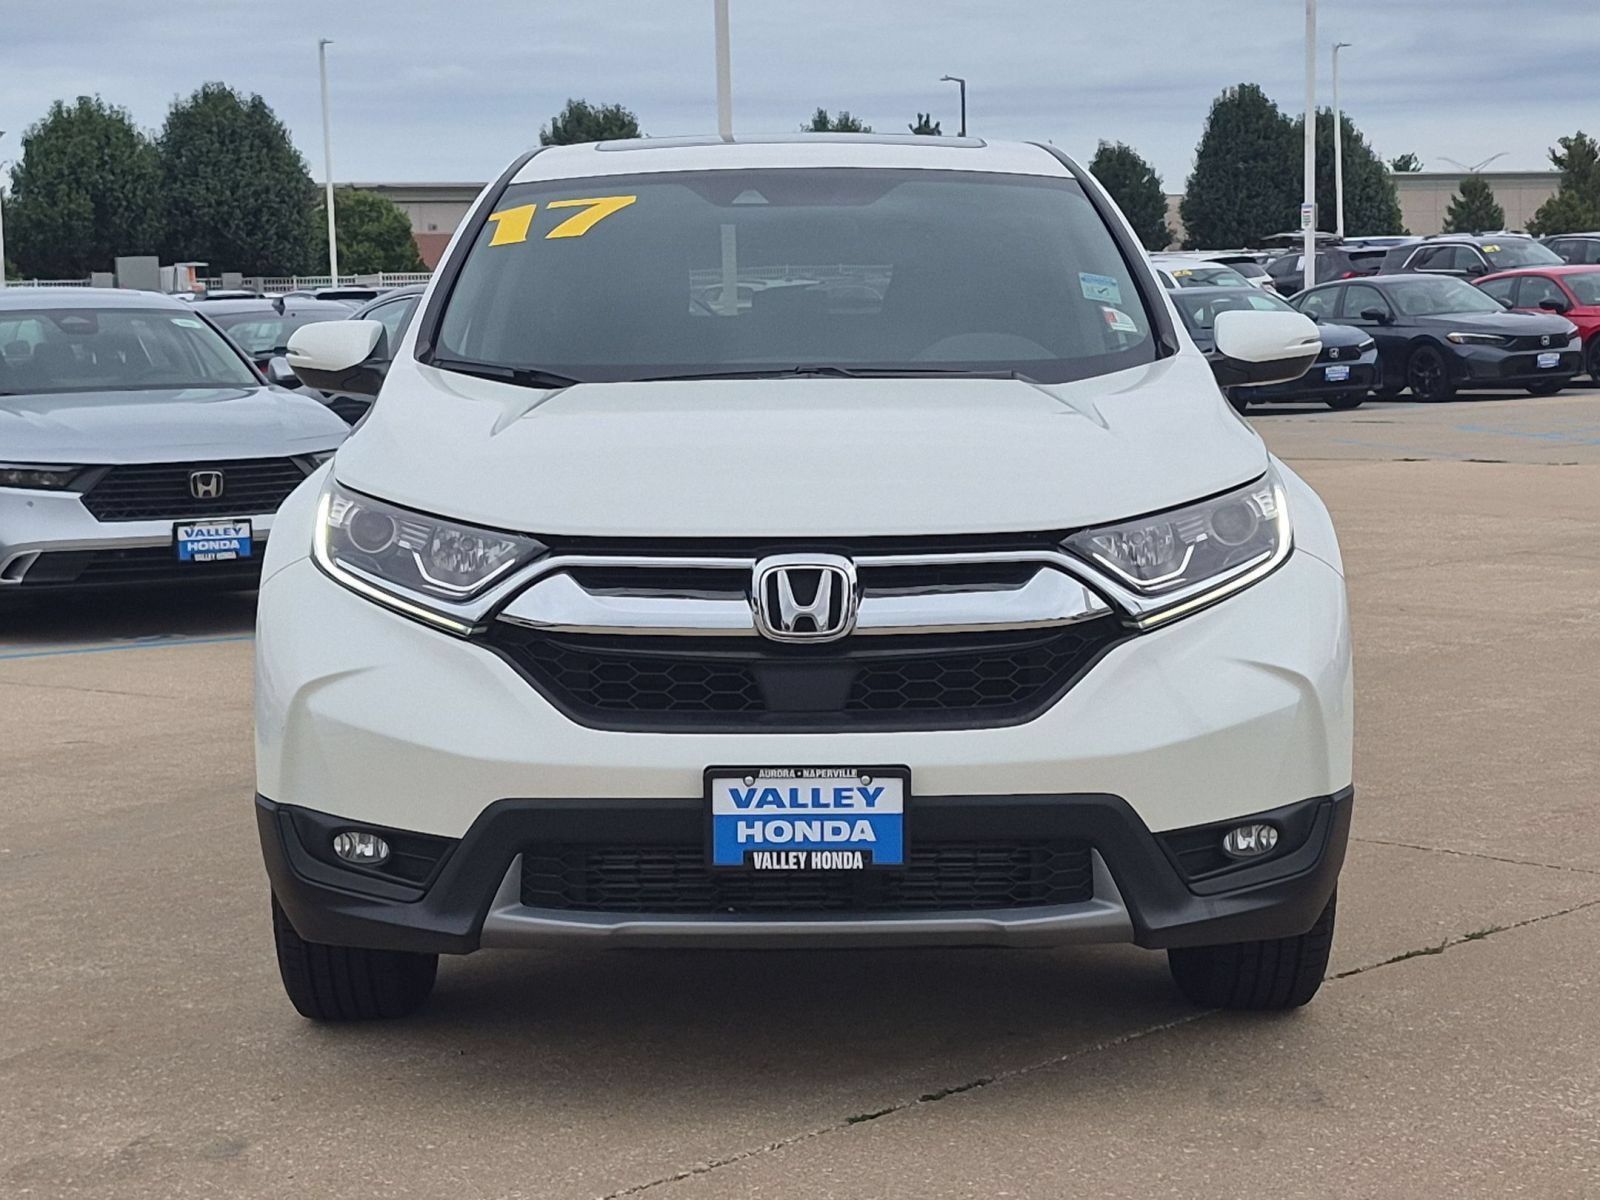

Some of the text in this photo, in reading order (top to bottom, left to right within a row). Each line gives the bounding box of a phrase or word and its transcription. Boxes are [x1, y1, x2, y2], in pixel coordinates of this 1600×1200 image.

[488, 195, 637, 247] 17
[184, 527, 242, 538] VALLEY
[187, 540, 240, 551] HONDA
[758, 768, 858, 778] AURORA NAPERVILLE
[728, 787, 885, 809] VALLEY
[737, 819, 877, 843] HONDA
[753, 851, 863, 870] VALLEY HONDA
